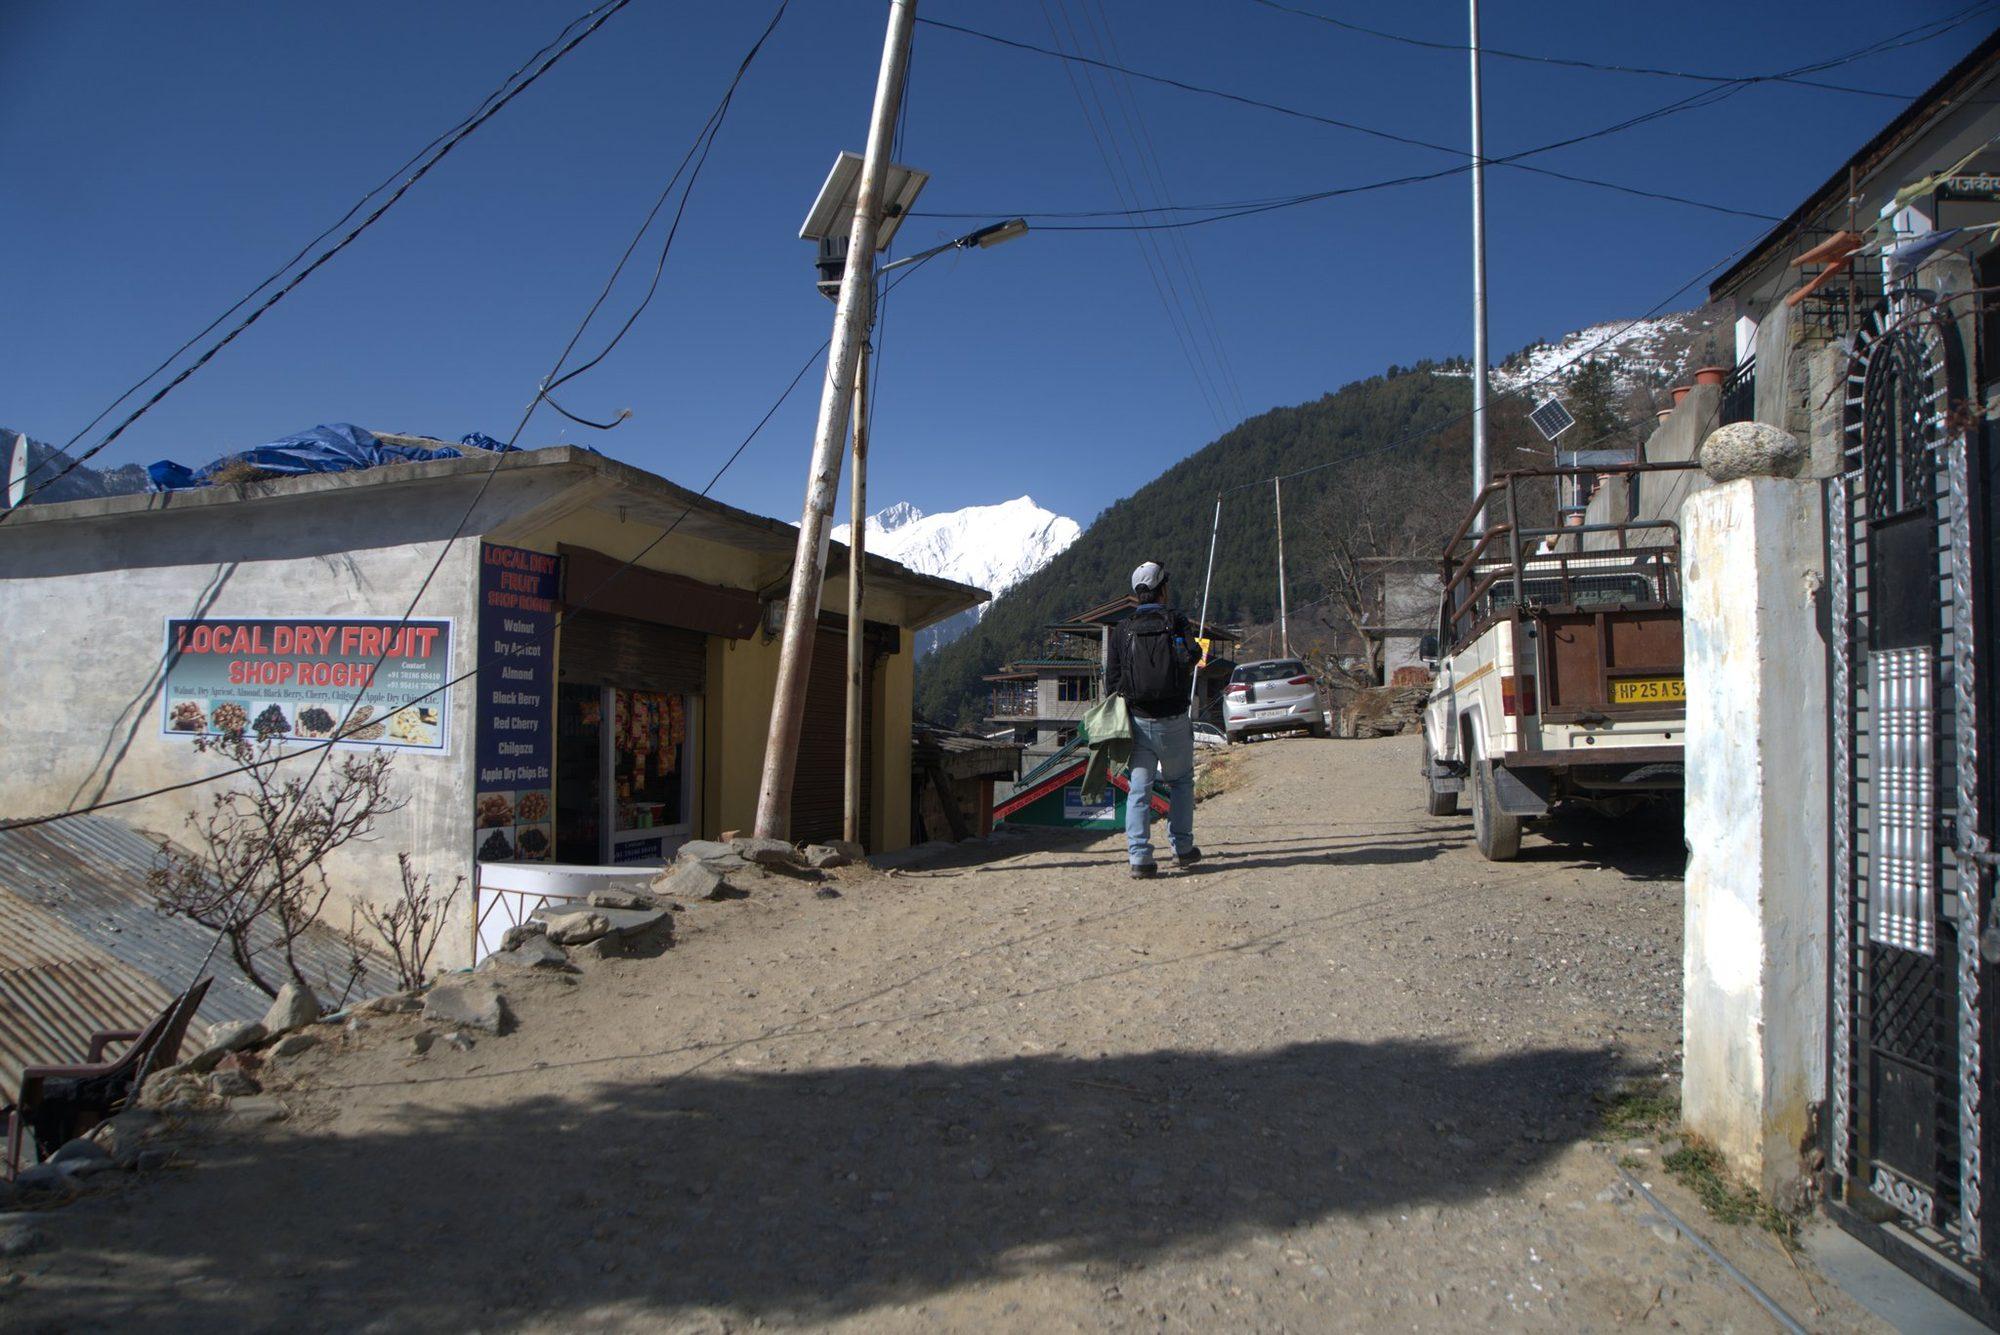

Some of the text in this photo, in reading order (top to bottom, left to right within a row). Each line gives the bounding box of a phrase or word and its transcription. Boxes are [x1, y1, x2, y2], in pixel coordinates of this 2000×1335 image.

[485, 544, 555, 576] LOCAL DRY
[501, 572, 540, 593] FRUIT
[488, 590, 518, 608] SHOP
[504, 618, 534, 634] Walnut
[178, 625, 439, 658] LOCAL DRY FRUIT
[494, 640, 541, 656] Dry Apricot
[228, 660, 374, 688] SHOP ROGHI
[401, 662, 426, 670] Contact
[502, 666, 534, 680] Almond
[1620, 684, 1637, 698] HP
[1640, 684, 1658, 698] 25
[1662, 683, 1669, 697] A
[492, 691, 540, 707] Black Berry
[494, 716, 538, 731] Red Cherry
[481, 766, 549, 782] Apple Dry Chips Etc
